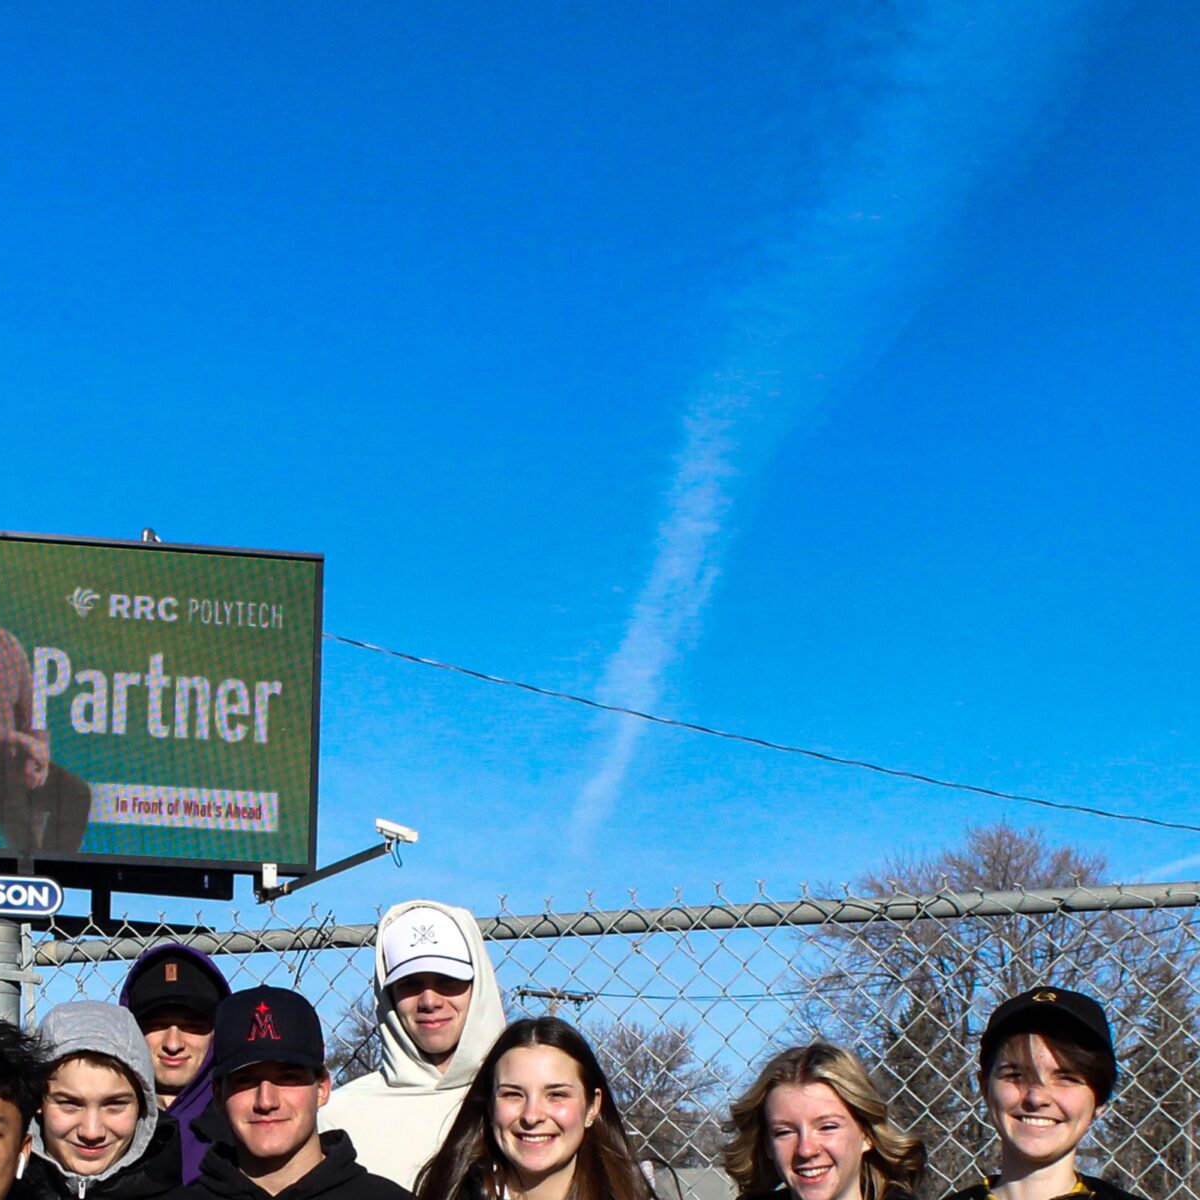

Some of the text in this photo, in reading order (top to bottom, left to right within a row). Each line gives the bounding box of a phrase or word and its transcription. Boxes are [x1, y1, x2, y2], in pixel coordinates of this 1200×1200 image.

[109, 594, 283, 629] RRC POLYTECH
[31, 646, 283, 744] Partner
[115, 797, 262, 820] In Front of What's Ahead
